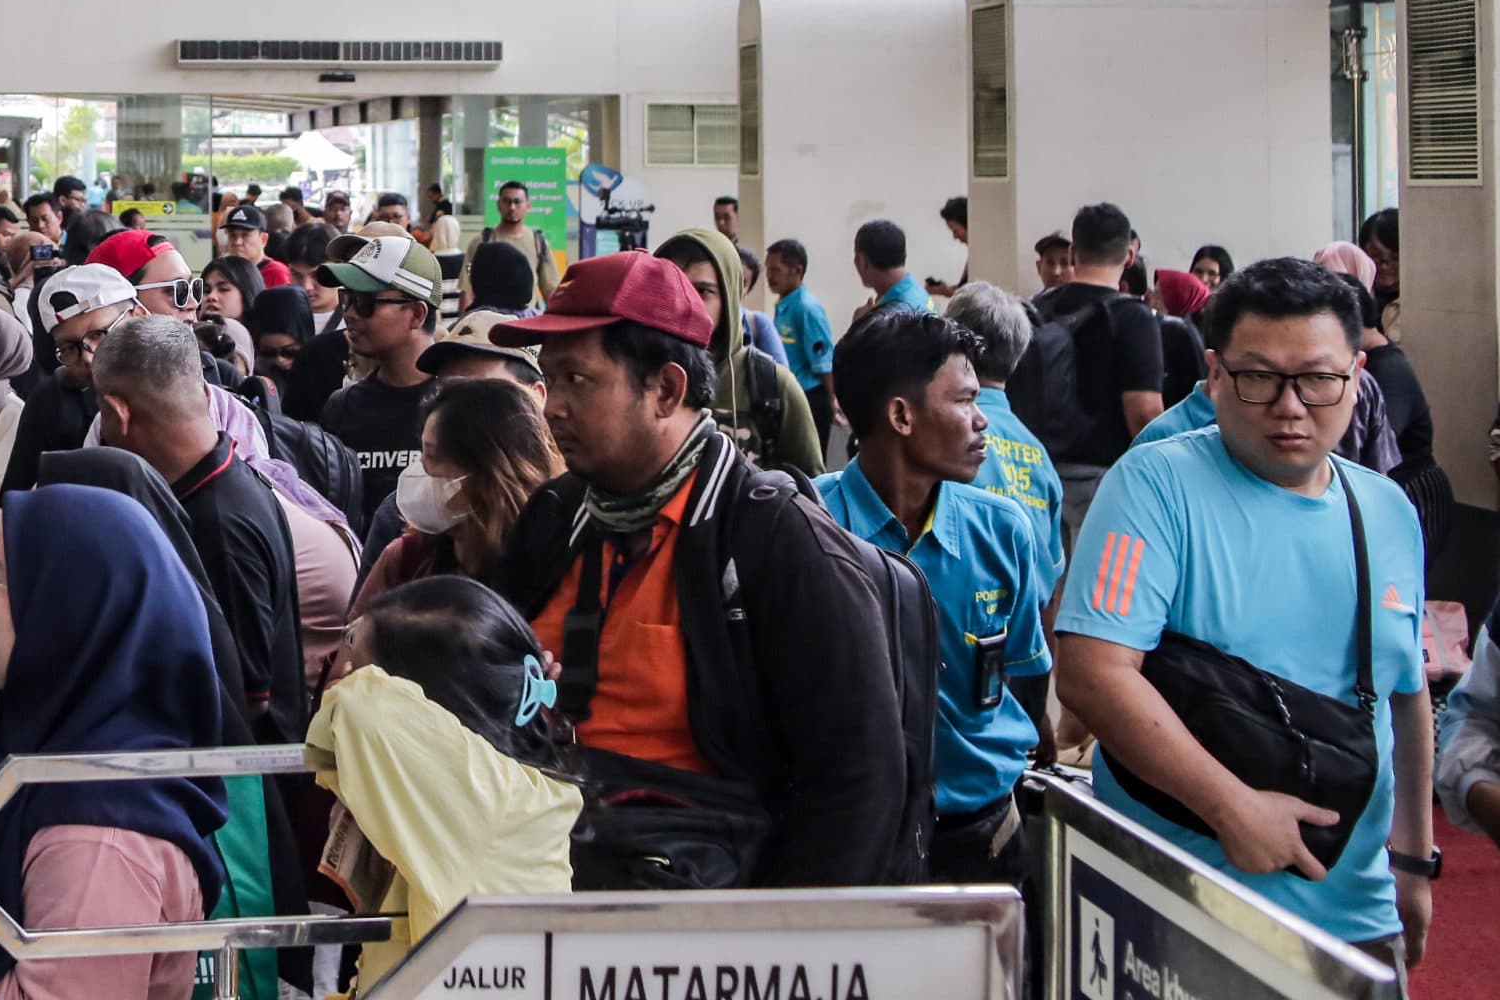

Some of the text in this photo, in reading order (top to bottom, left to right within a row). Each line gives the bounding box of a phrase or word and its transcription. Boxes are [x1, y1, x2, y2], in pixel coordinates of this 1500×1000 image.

[443, 966, 526, 990] JALUR
[579, 963, 871, 1000] MATARMAJA
[1124, 940, 1161, 999] Area
